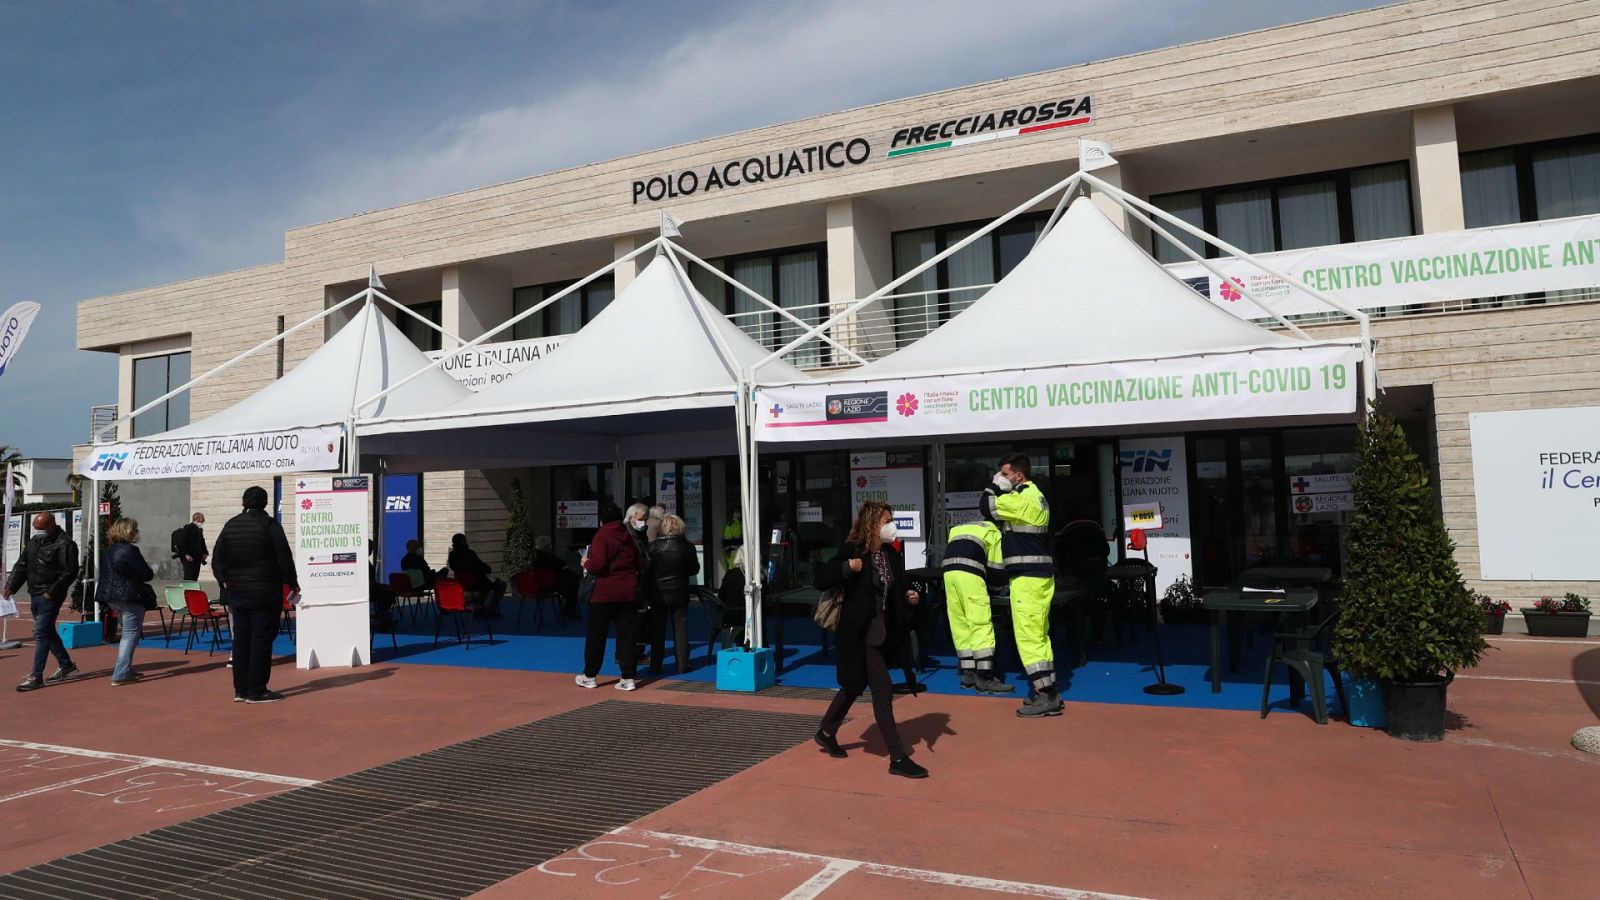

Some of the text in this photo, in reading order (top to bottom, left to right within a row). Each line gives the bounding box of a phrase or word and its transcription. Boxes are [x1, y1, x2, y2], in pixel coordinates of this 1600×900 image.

[632, 137, 871, 205] POLO ACQUATICO
[1302, 262, 1381, 291] CENTRO
[1391, 244, 1553, 283] VACCINAZIONE
[968, 363, 1347, 412] CENTRO VACCINAZIONE ANTI-COVID 19
[843, 398, 869, 407] REGIONE
[133, 434, 299, 460] FEDERAZIONE ITALIANA NUOTO
[90, 452, 129, 472] FIN
[135, 464, 160, 475] Centro
[161, 462, 174, 474] dei
[175, 461, 212, 475] Campioni
[214, 461, 231, 470] POLO
[231, 459, 271, 470] ACQUATICO
[275, 458, 295, 468] OSTIA
[1120, 475, 1172, 486] EDERAZIONE
[1542, 467, 1554, 489] il
[856, 490, 888, 503] CENTRO
[1148, 486, 1179, 496] NUOTO
[385, 496, 411, 510] FIN
[300, 512, 333, 524] CENTRO
[1139, 511, 1154, 520] DOSE
[900, 519, 914, 527] DOSE
[300, 524, 361, 536] VACCINAZIONE
[300, 536, 362, 549] ANTI-COVID 19
[310, 570, 355, 578] ACCOGLIENZA
